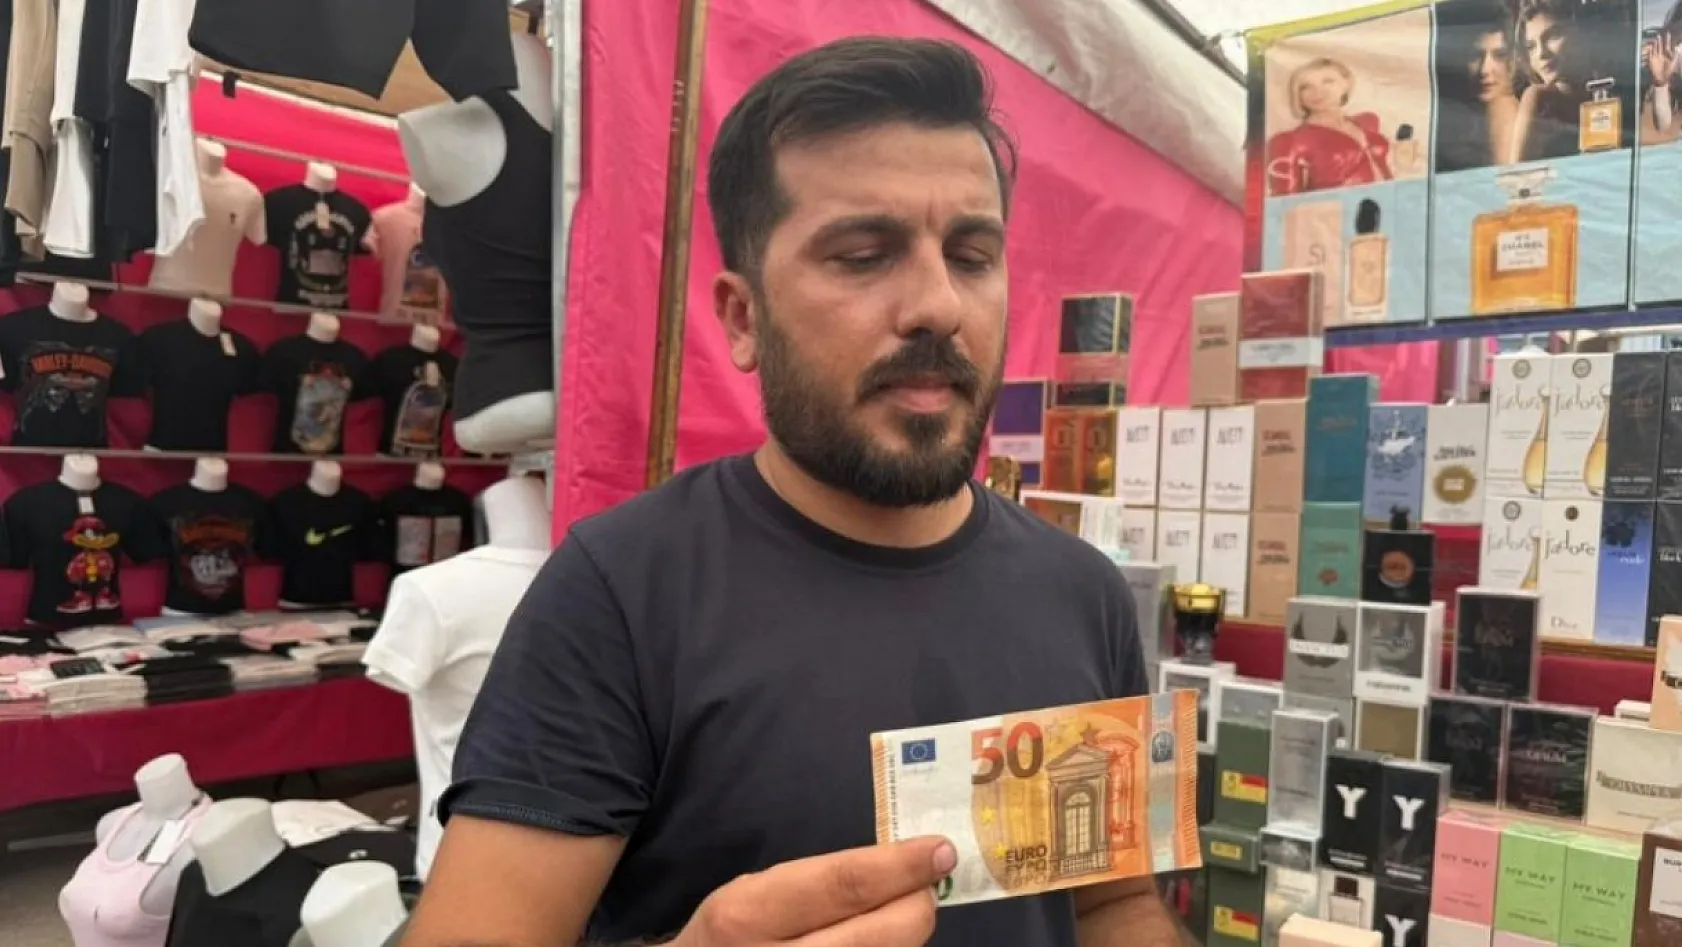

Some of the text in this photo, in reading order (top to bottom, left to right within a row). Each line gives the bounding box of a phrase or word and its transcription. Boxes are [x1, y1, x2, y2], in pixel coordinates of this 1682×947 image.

[1501, 241, 1544, 252] CHANEL
[971, 721, 1043, 784] 50
[1335, 783, 1367, 819] Y
[1393, 794, 1424, 830] Y
[1006, 845, 1047, 864] EURO
[1461, 856, 1488, 868] WAY
[1505, 866, 1556, 883] MY WAY
[1572, 882, 1626, 900] MY WAY
[1386, 913, 1418, 947] Y
